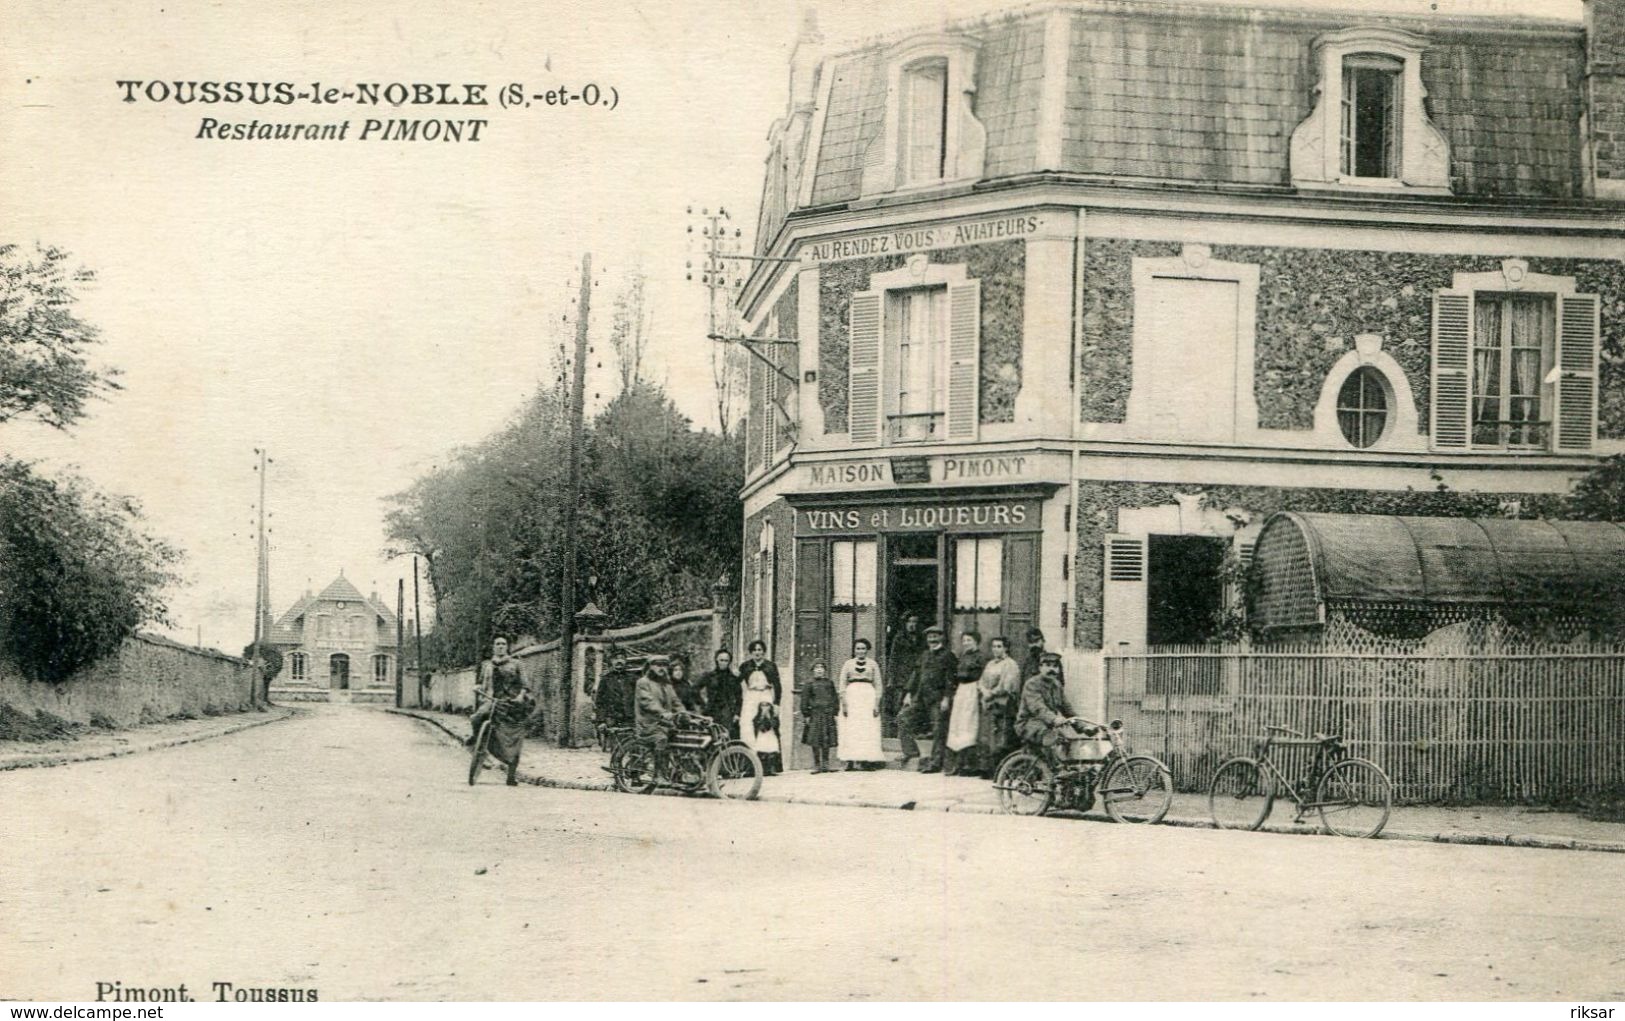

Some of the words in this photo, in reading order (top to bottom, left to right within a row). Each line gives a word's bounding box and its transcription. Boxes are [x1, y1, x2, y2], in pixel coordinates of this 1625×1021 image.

[811, 242, 830, 261] AU
[954, 215, 1037, 244] AVIATEURS
[810, 464, 884, 486] MAISON
[945, 457, 1027, 480] PIMONT
[806, 509, 860, 529] VINS
[870, 509, 888, 528] et
[899, 504, 1026, 528] LIQUEURS
